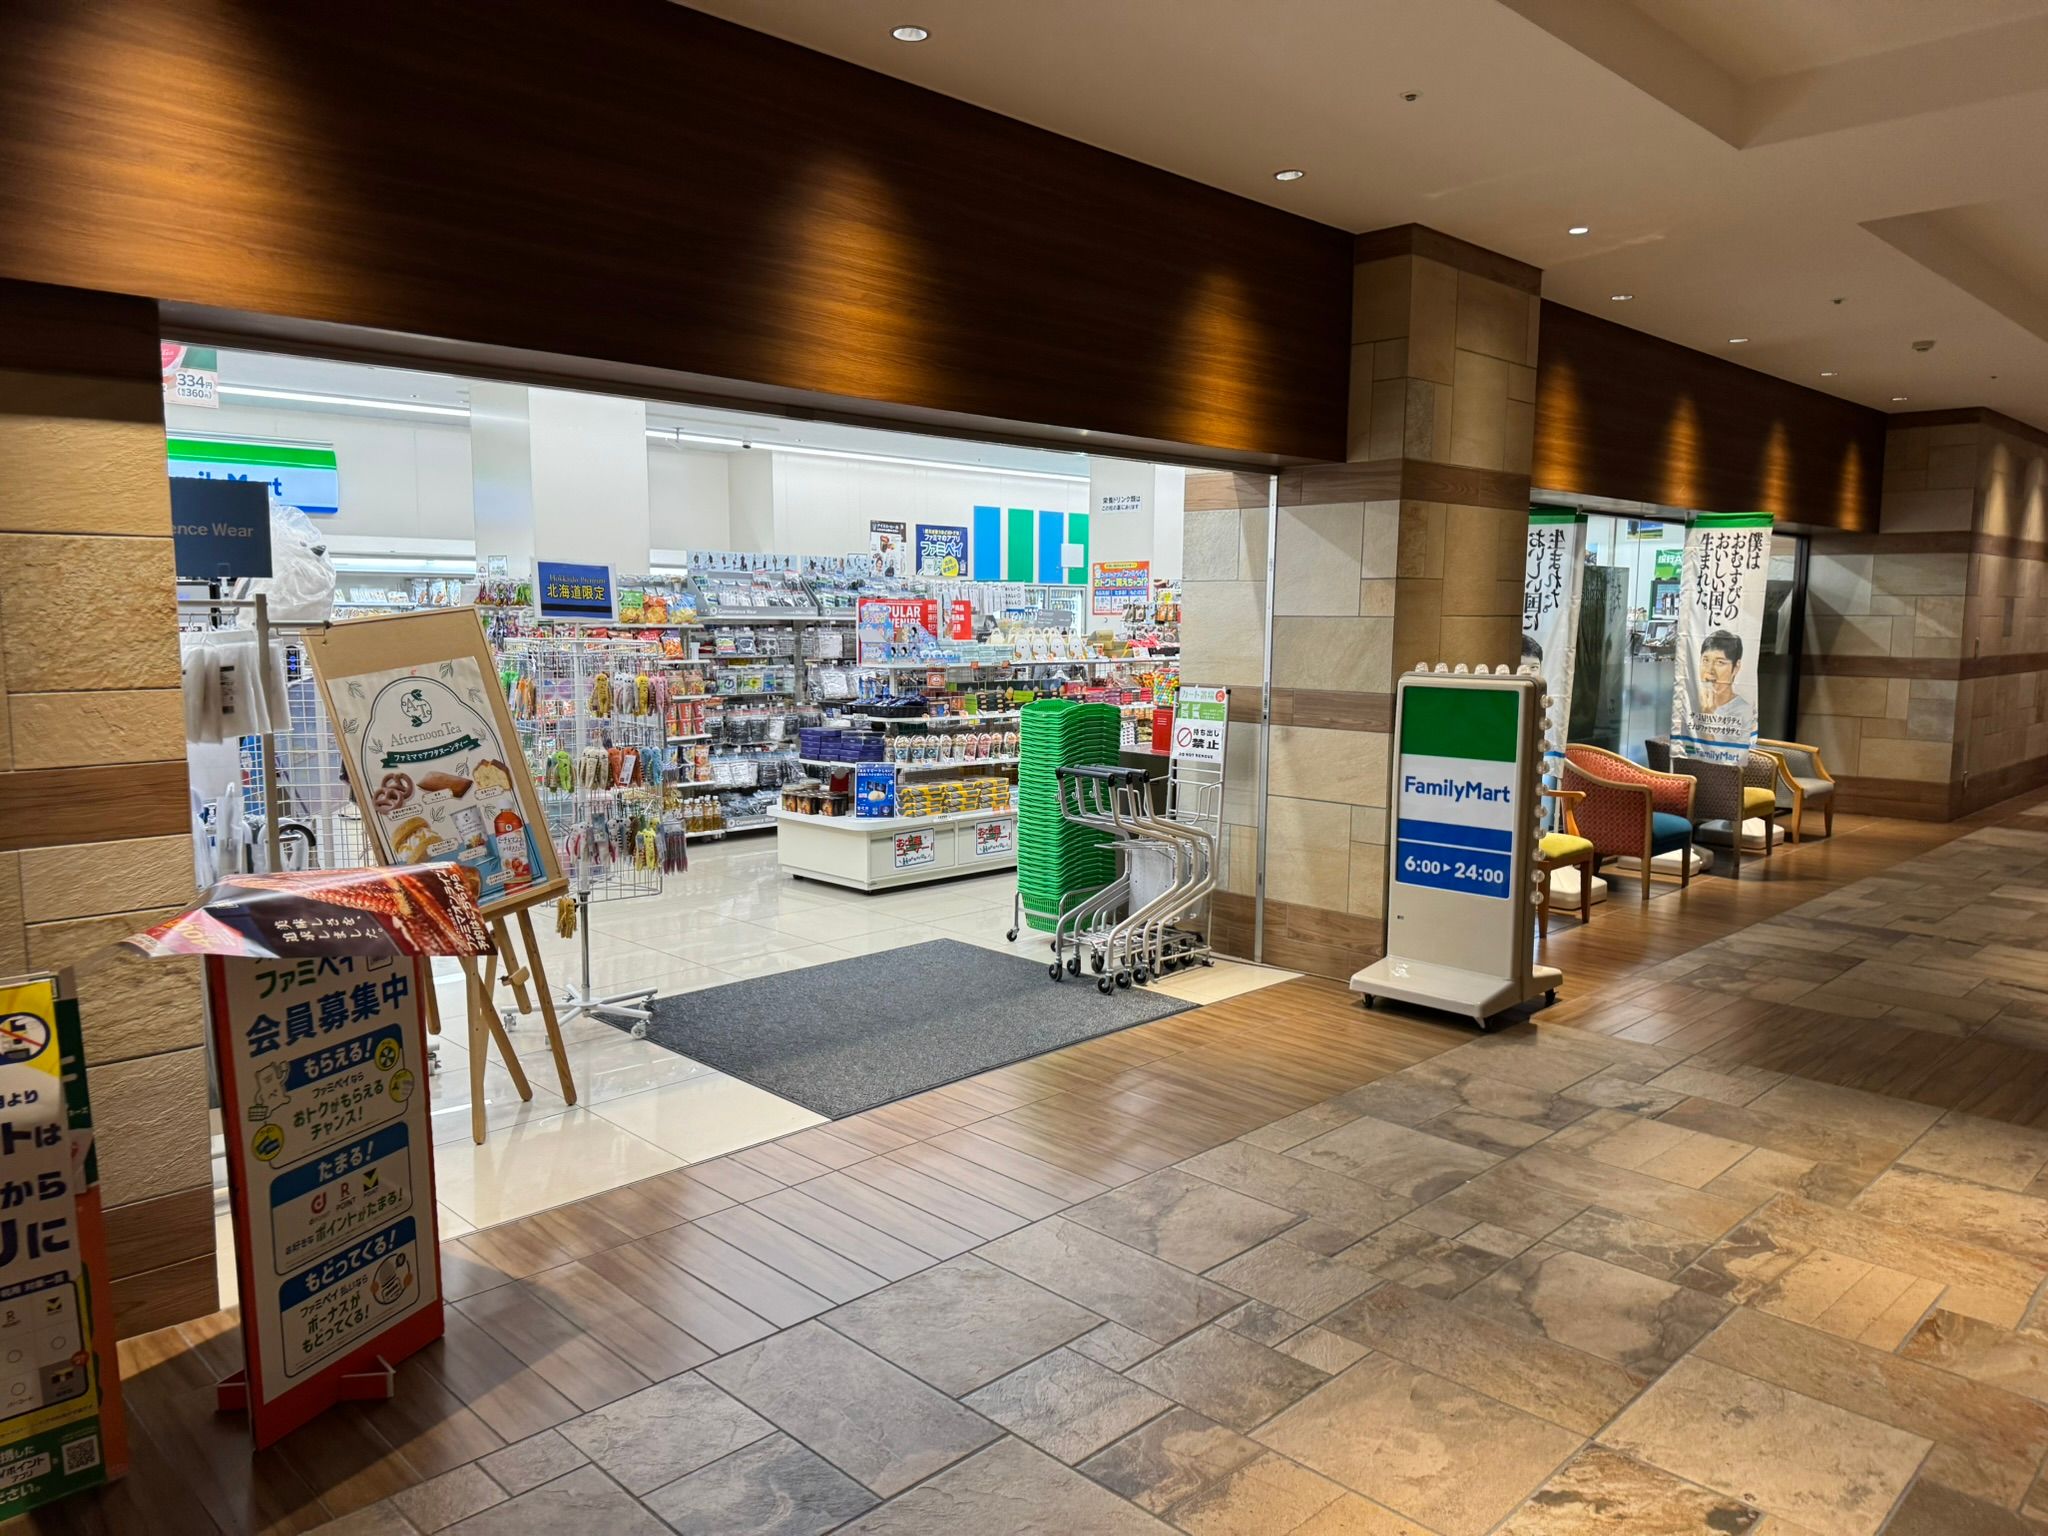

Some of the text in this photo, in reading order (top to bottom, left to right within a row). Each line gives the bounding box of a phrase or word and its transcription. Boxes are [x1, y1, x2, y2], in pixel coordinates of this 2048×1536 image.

[177, 373, 213, 390] 334円
[212, 523, 254, 537] Wear
[920, 541, 963, 558] ファミペイ
[1746, 532, 1763, 570] 僕は
[1696, 532, 1714, 610] 生まれた。
[1708, 532, 1731, 627] おいしい国に
[1724, 532, 1747, 621] おむすびの
[547, 583, 606, 600] 北海道限定
[391, 721, 462, 747] Afternoon Tea
[1192, 738, 1219, 750] 禁止
[1193, 728, 1220, 737] 持ち出し
[1404, 775, 1511, 803] FamilyMart
[1404, 855, 1504, 884] 6:00 24:00
[245, 972, 409, 1058] 会員募集中
[304, 1037, 373, 1079] もらえる!
[293, 1079, 384, 1128] おトクがもらえる
[312, 1072, 364, 1099] ファミペイなら
[312, 1106, 363, 1141] チャンス!
[317, 1140, 374, 1183] たまる!
[305, 1230, 396, 1292] もどってくる!
[302, 1304, 369, 1353] もどってくる!
[307, 1289, 361, 1335] ボーナスが
